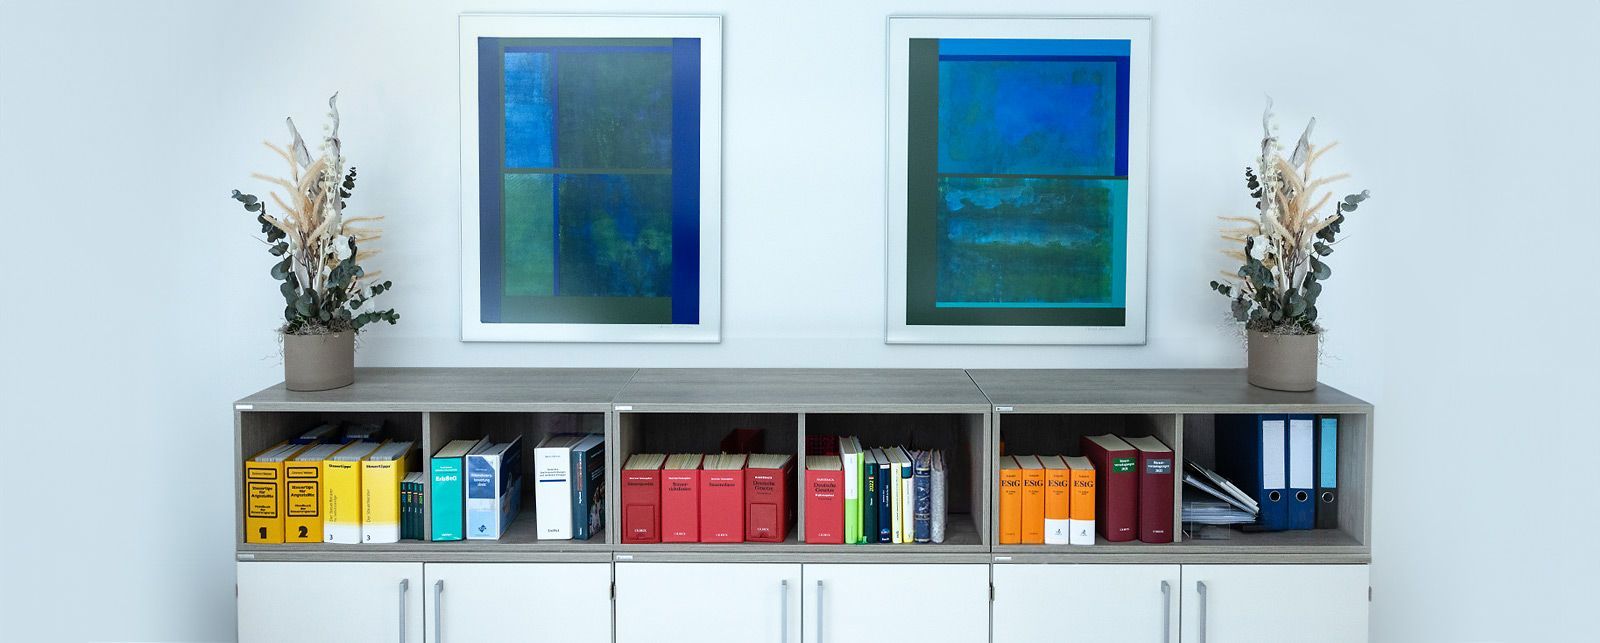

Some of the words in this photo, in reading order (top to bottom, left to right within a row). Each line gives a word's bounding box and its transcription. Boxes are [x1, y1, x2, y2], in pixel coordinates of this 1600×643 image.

[1073, 480, 1094, 488] EStG
[259, 527, 267, 539] 1
[298, 525, 308, 538] 2
